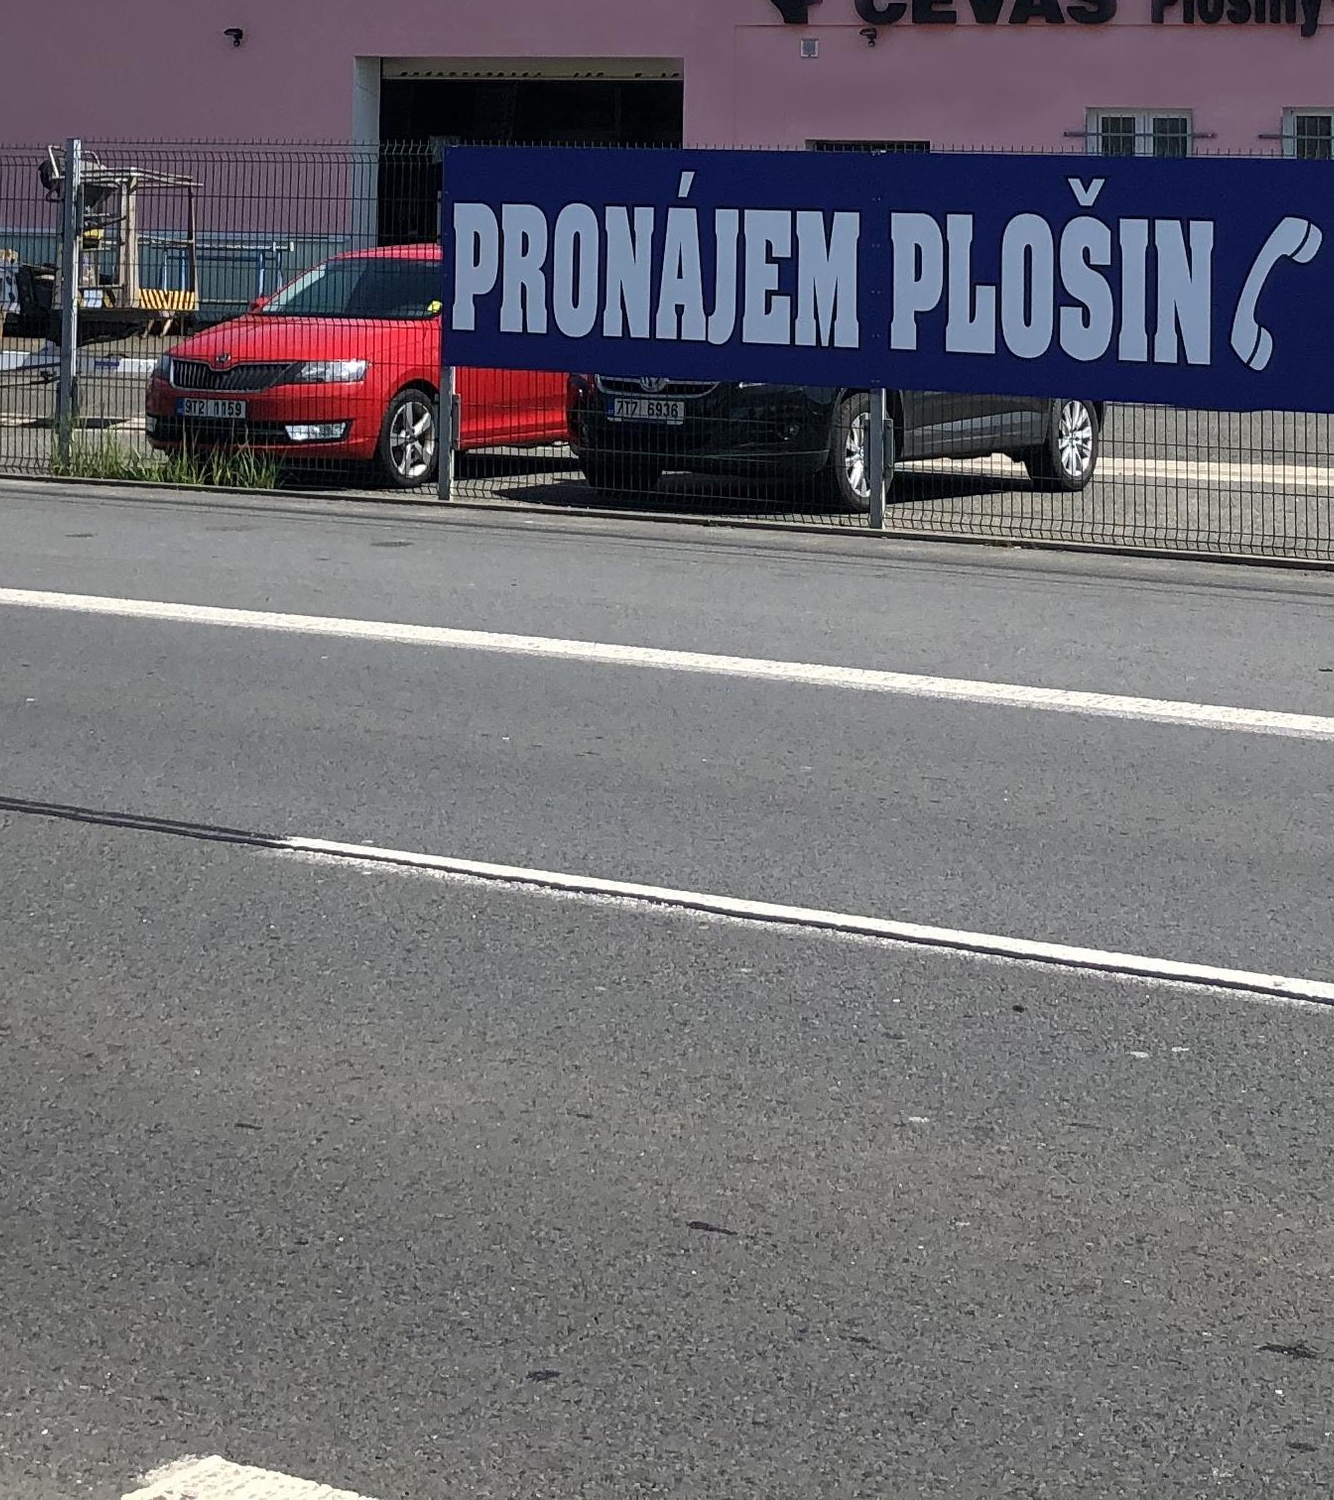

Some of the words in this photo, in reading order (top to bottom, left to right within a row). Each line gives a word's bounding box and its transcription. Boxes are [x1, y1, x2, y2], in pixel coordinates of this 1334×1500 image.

[452, 171, 860, 348] PRONÁJEM
[890, 177, 1215, 365] PLOŠIN
[648, 402, 679, 418] 6936
